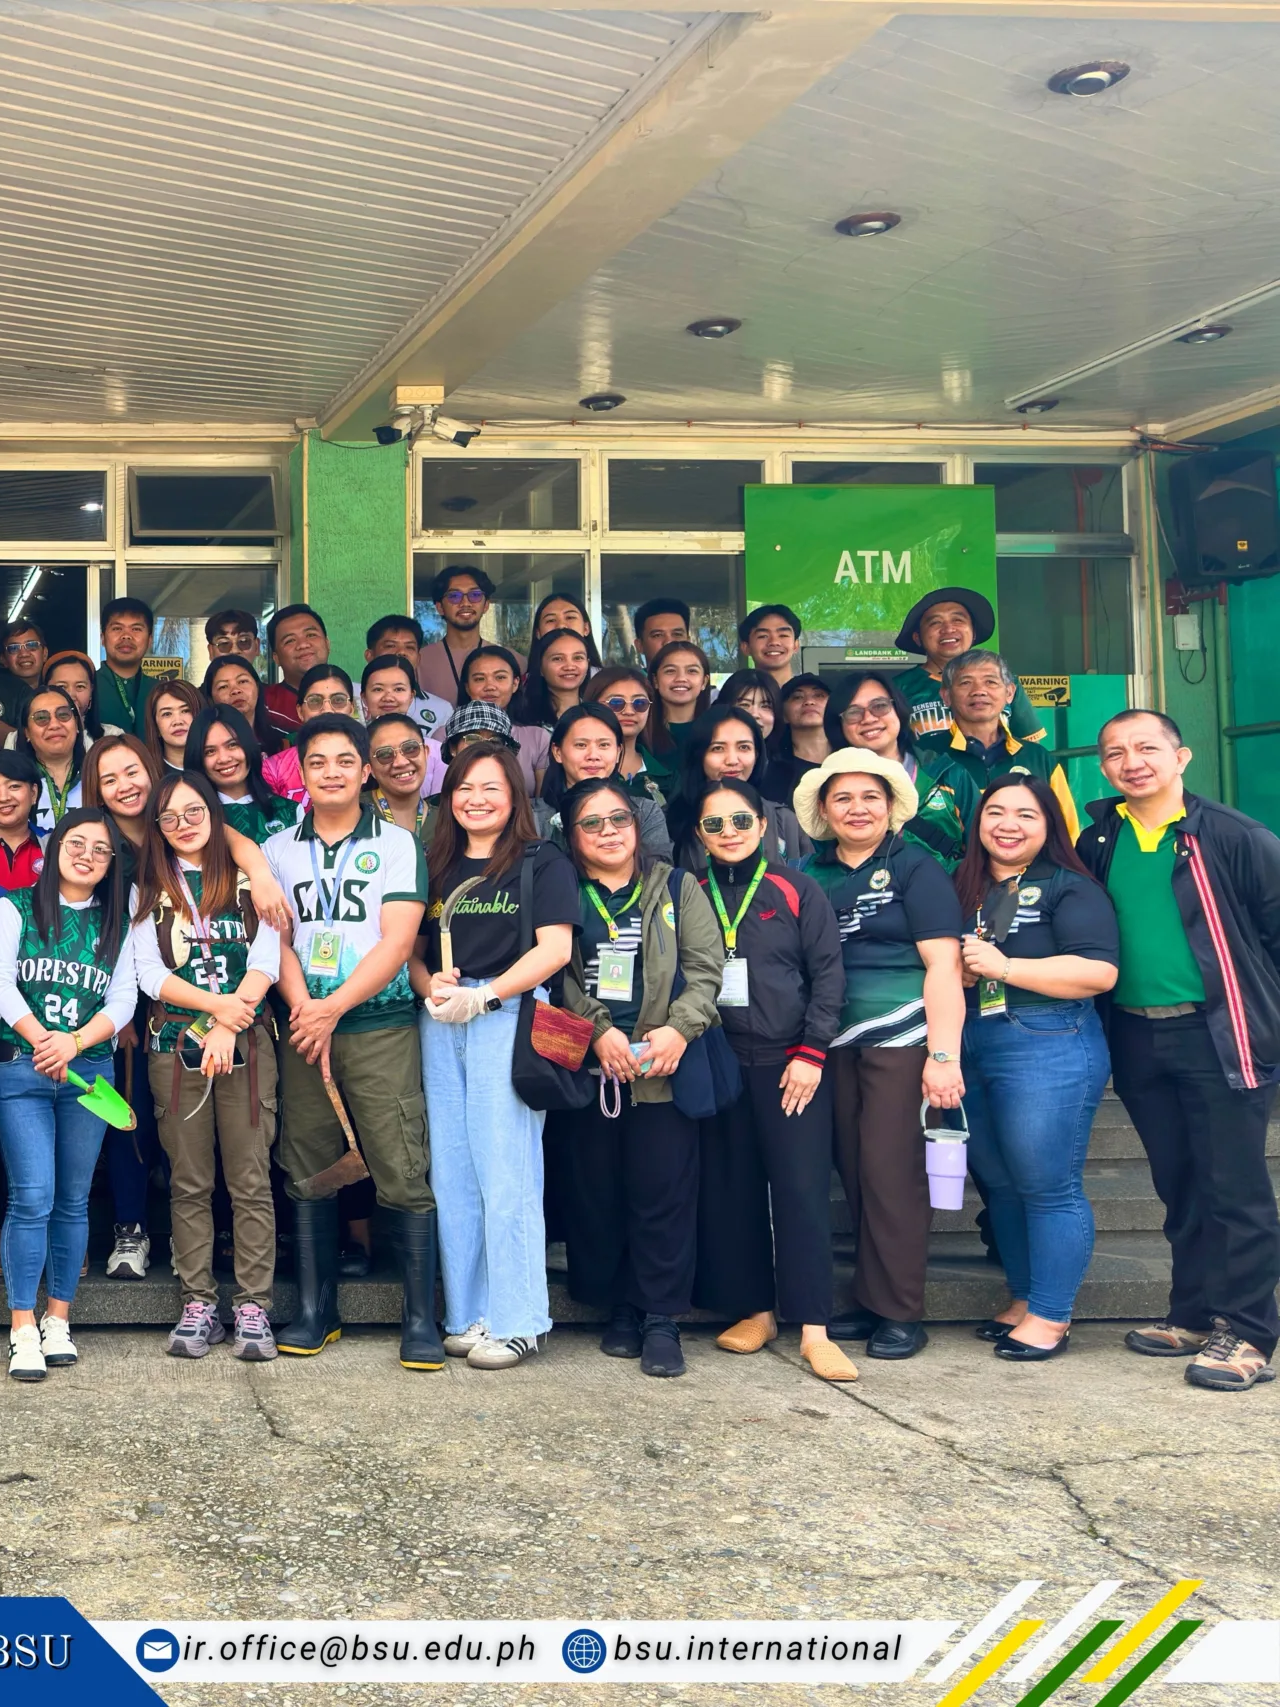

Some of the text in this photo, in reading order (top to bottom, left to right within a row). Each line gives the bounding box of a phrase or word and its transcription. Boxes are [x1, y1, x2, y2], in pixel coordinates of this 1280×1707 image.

[834, 550, 912, 584] ATM
[1020, 678, 1068, 686] WARNING
[292, 878, 370, 923] CNS
[44, 993, 79, 1027] 24
